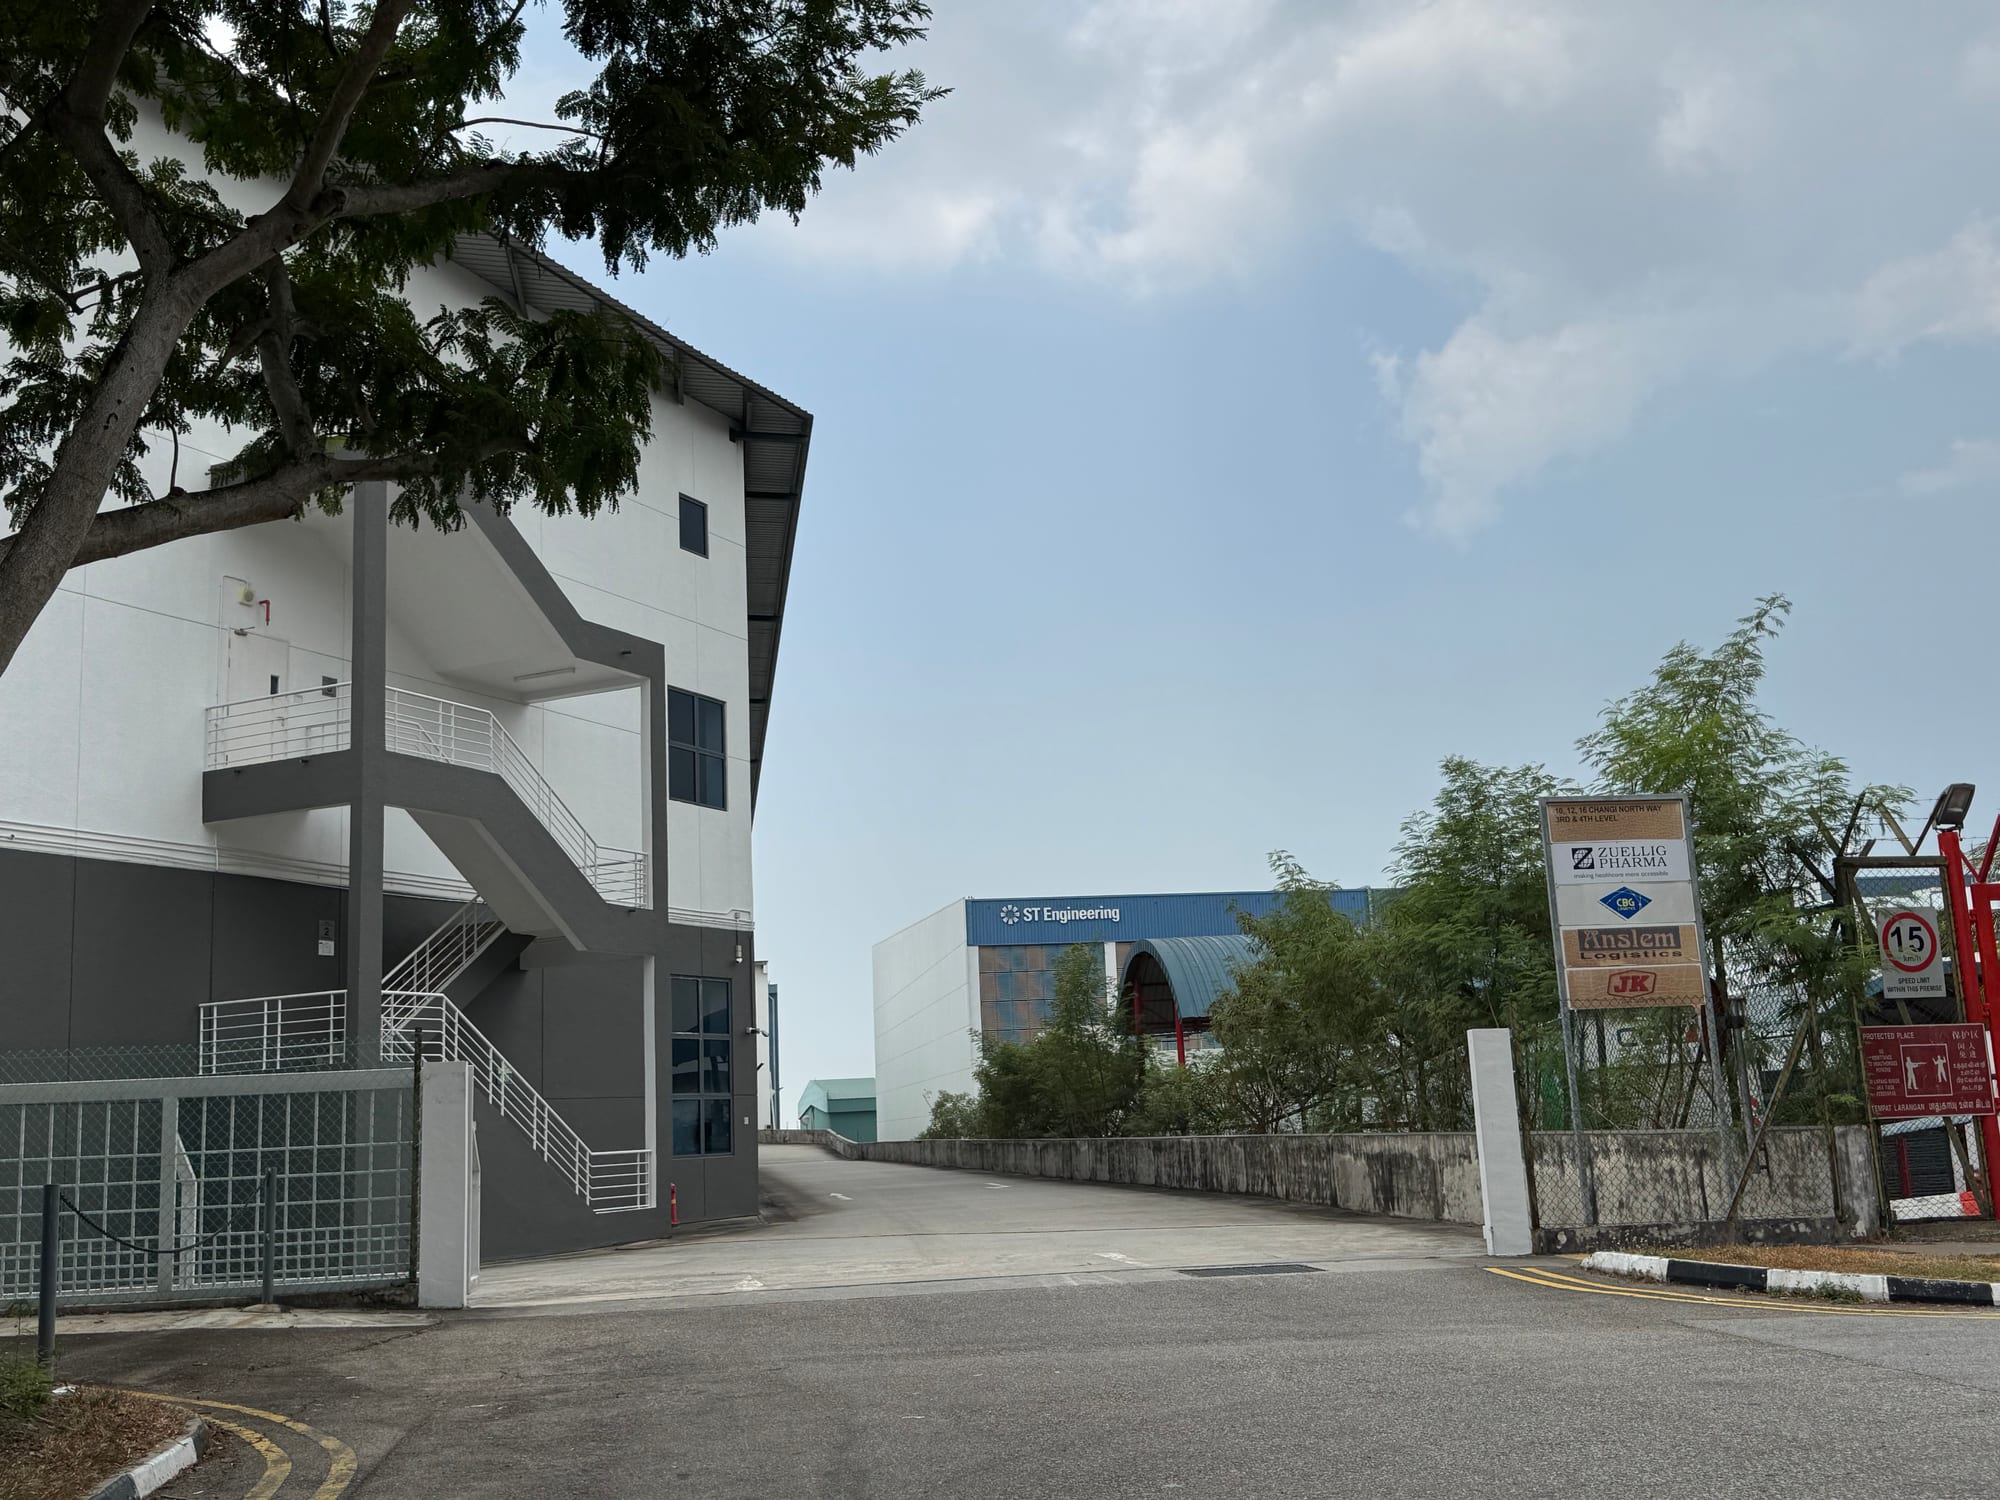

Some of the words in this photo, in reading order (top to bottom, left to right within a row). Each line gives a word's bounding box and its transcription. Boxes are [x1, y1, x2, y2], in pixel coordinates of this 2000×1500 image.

[1619, 805, 1645, 813] NORTH
[1556, 815, 1570, 823] 3RD
[1579, 815, 1593, 823] 4TH
[1598, 845, 1667, 857] ZUELLIG
[1599, 857, 1668, 869] PHARMA
[1616, 898, 1635, 907] CBG
[1023, 907, 1041, 922] ST
[1043, 905, 1120, 924] Engineering
[1890, 926, 1925, 953] 15
[1580, 949, 1682, 960] Logistics
[1613, 975, 1650, 993] JK
[1916, 976, 1930, 984] LIMIT
[1862, 1032, 1895, 1040] PROTECTED
[1896, 1031, 1915, 1039] PLACE
[1893, 1103, 1925, 1112] LARANGAN
